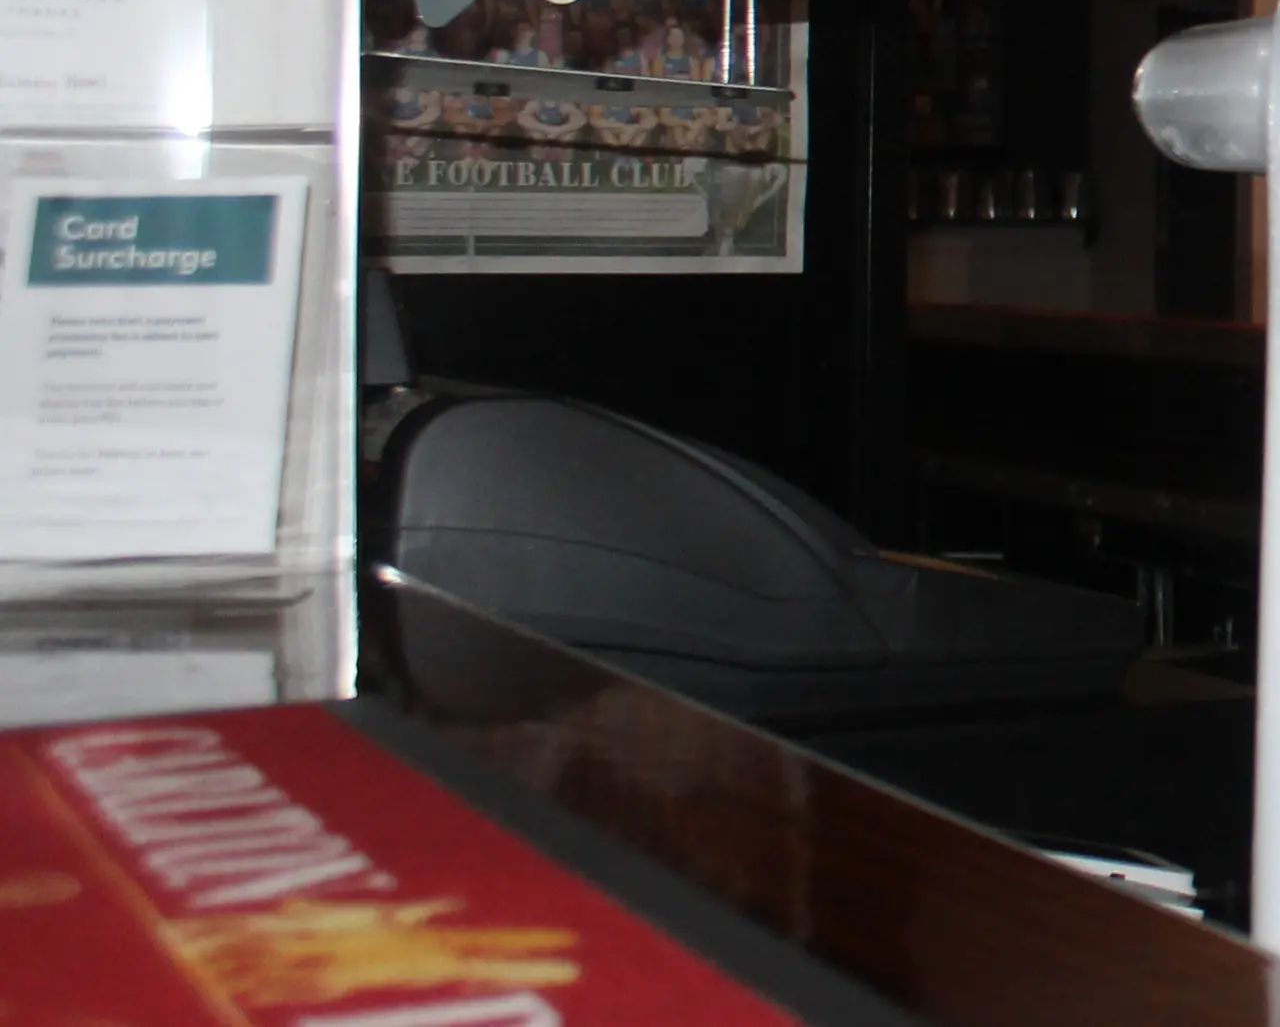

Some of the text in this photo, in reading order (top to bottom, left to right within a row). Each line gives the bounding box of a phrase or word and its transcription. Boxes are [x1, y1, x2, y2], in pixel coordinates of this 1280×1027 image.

[427, 159, 600, 187] FOOTBALL
[61, 215, 139, 241] Card
[55, 245, 217, 274] Surcharge
